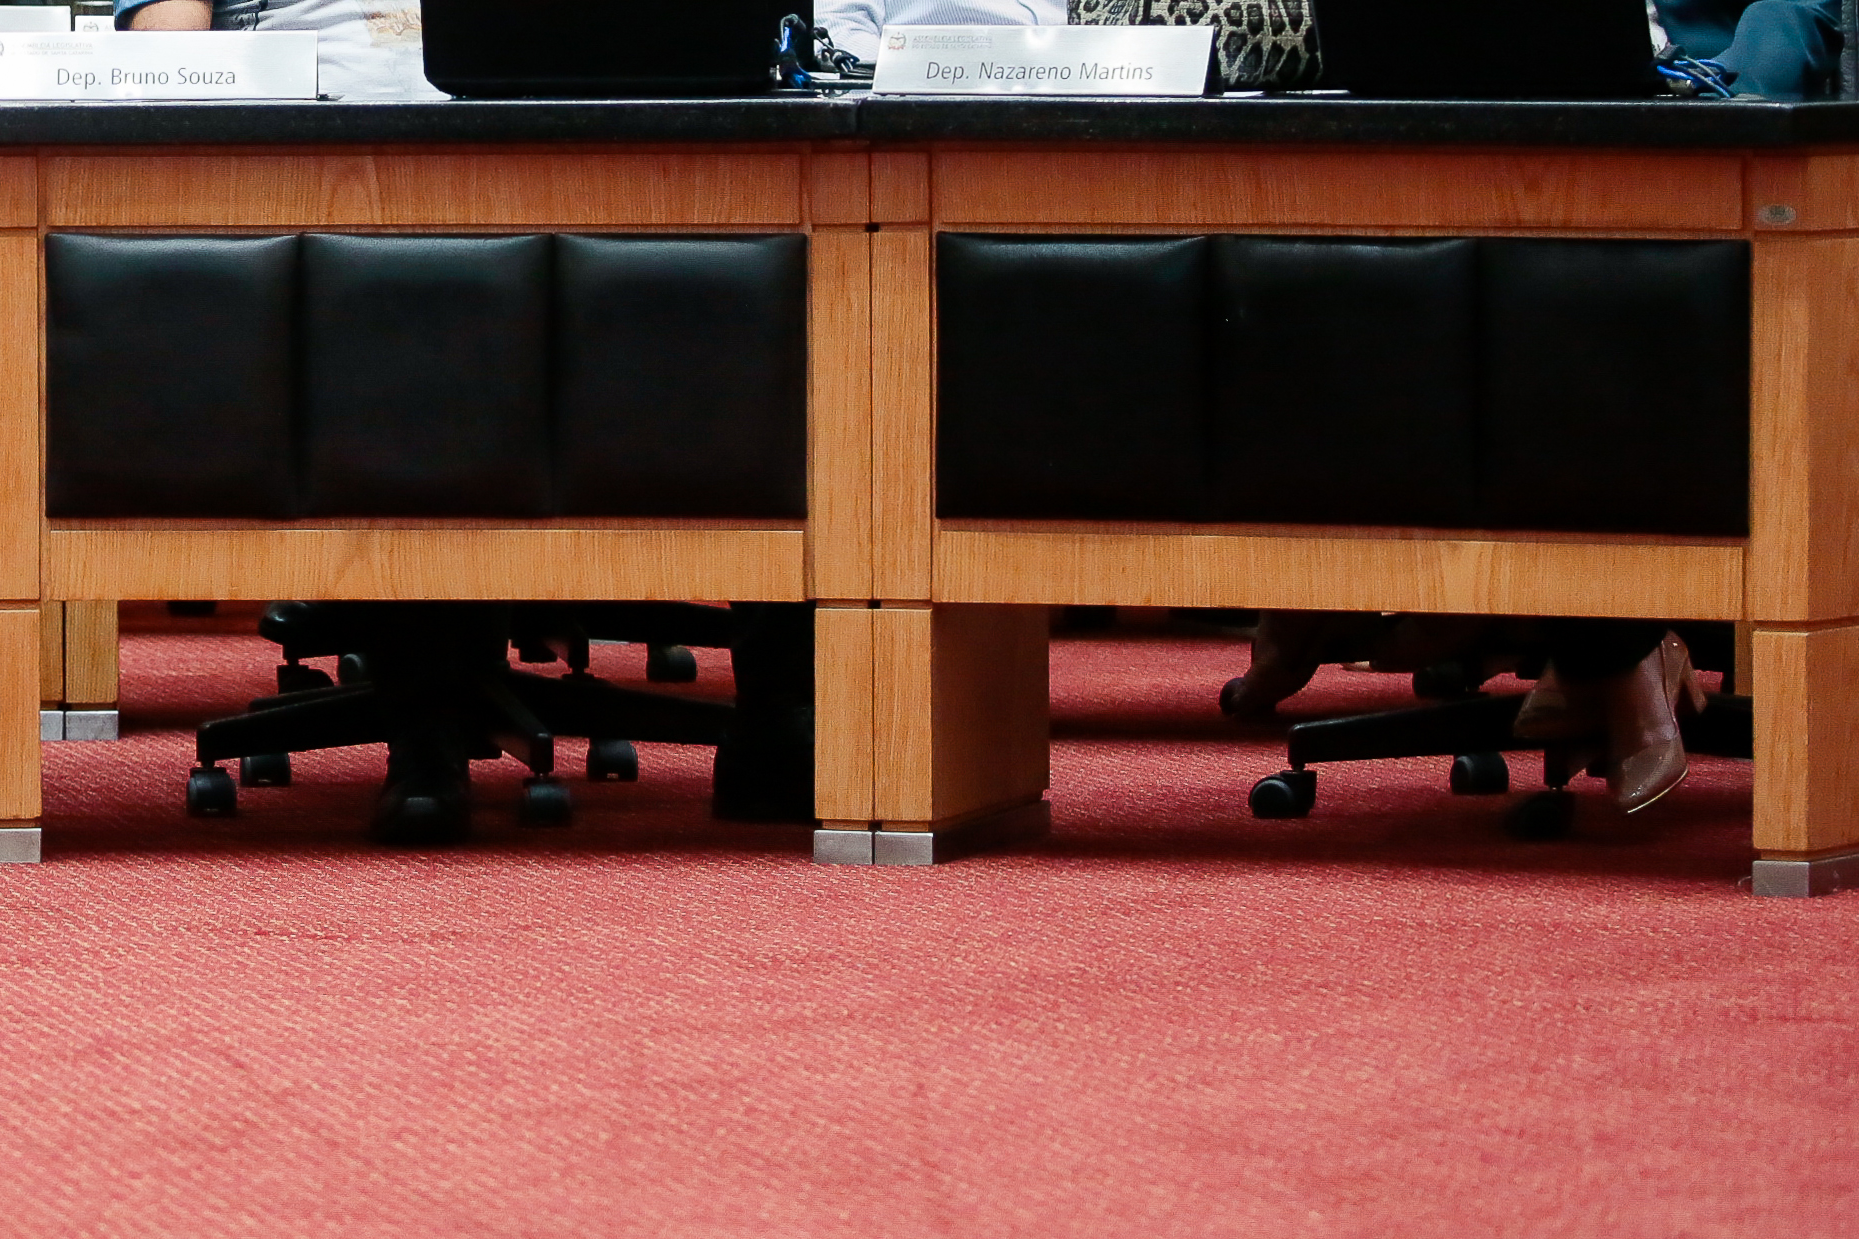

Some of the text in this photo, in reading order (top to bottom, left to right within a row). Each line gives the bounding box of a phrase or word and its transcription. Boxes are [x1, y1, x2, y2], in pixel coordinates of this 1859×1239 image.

[56, 67, 237, 89] Dep. Bruno Souza
[926, 61, 1153, 85] Dep. Nazareno Martins
